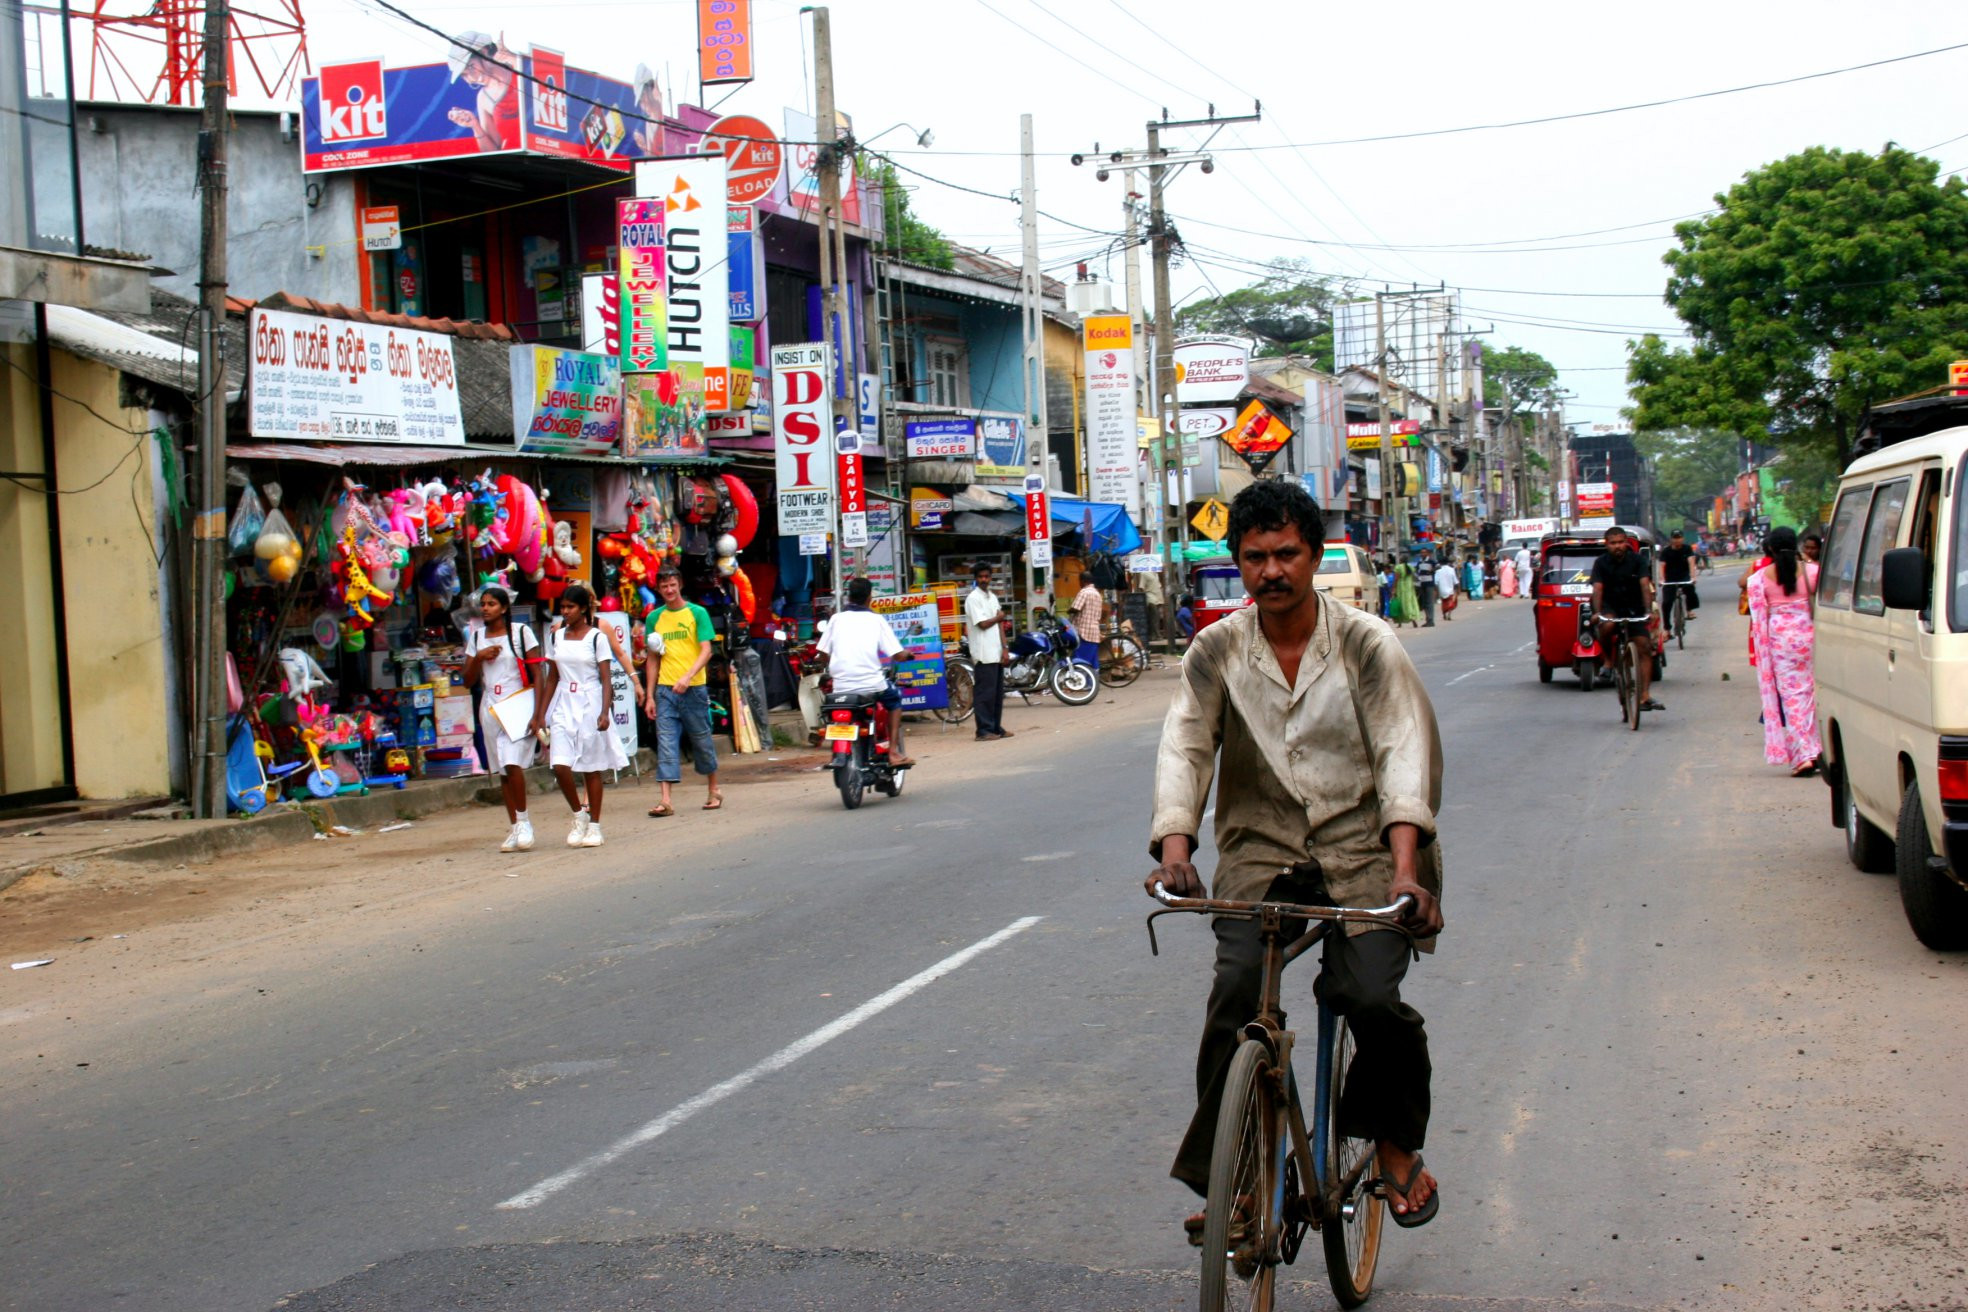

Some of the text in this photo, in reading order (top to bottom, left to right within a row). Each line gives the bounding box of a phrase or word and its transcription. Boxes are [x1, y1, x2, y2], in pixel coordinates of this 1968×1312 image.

[533, 75, 567, 129] kit
[321, 86, 385, 138] kit
[322, 153, 345, 162] COOL
[346, 150, 369, 159] ZONE
[752, 145, 774, 162] kit
[622, 224, 665, 247] ROYAL
[626, 253, 661, 370] JEWELLERY
[1088, 327, 1127, 339] Kodak
[775, 350, 823, 365] INSIST ON
[1189, 358, 1243, 368] PEOPLE'S
[554, 357, 606, 386] ROYAL
[1187, 368, 1221, 377] BANK
[541, 389, 618, 413] JEWELLERY
[708, 416, 745, 431] DSI
[783, 370, 824, 487] DSI
[1186, 418, 1209, 429] PET
[916, 445, 966, 455] SINGER
[846, 455, 858, 511] SANYO
[780, 493, 828, 508] FOOTWEAR
[785, 508, 825, 518] MODERN SHOE
[1032, 493, 1042, 539] SANYO
[1511, 524, 1543, 533] Rainco
[871, 595, 928, 608] COOL ZONE
[663, 631, 688, 640] PUMA
